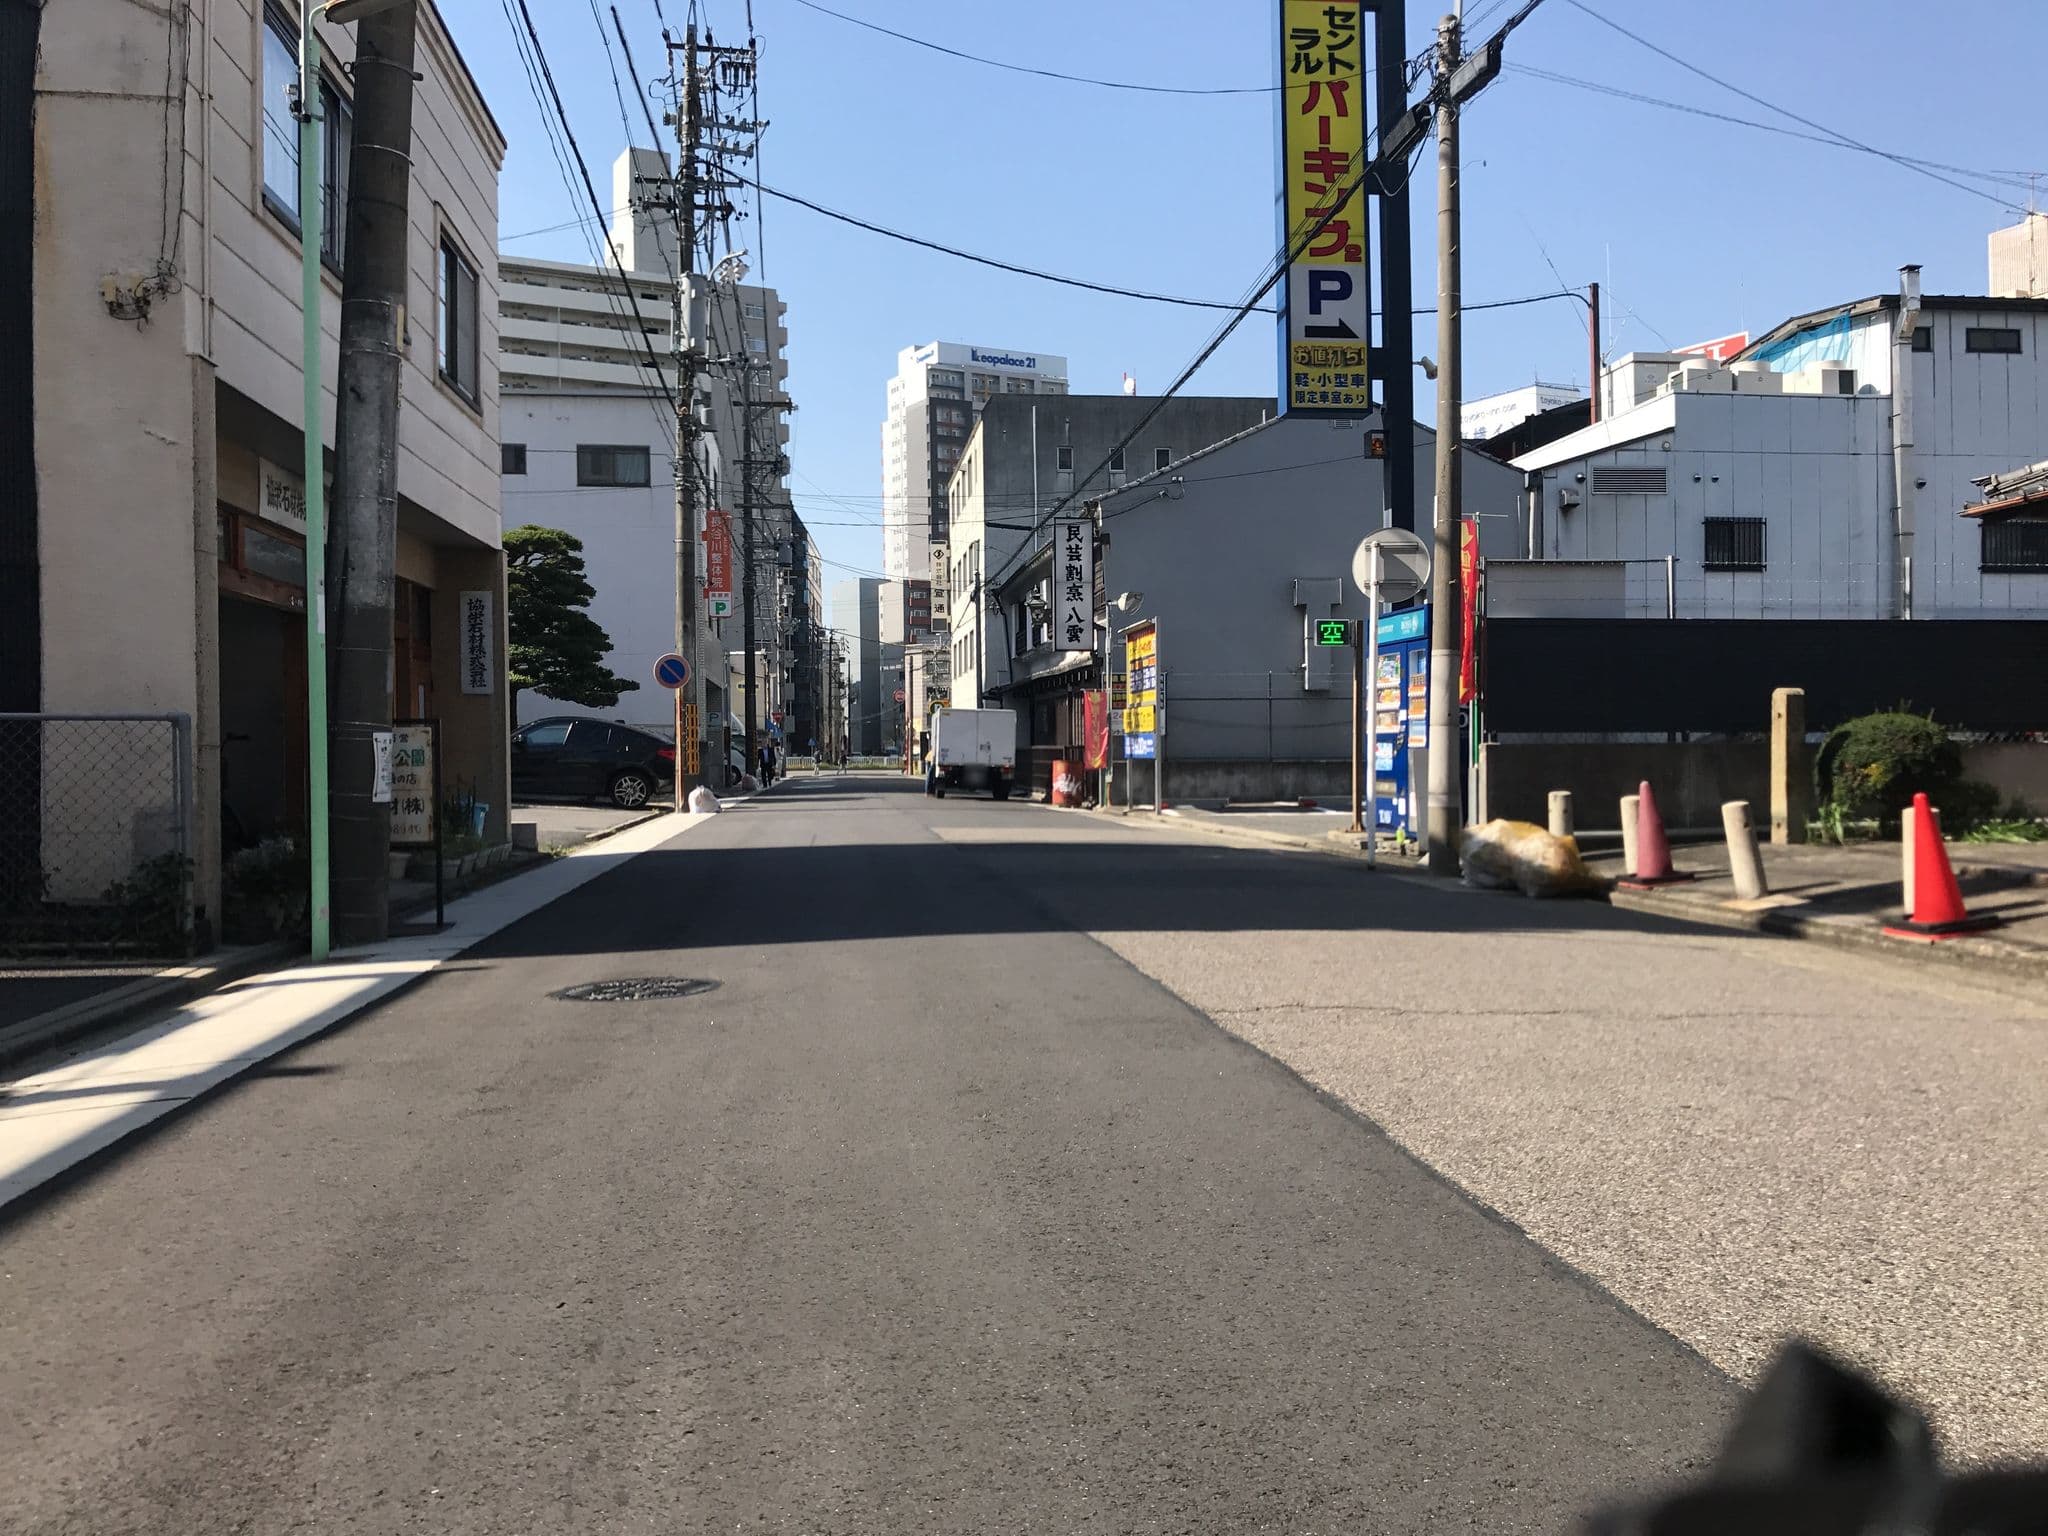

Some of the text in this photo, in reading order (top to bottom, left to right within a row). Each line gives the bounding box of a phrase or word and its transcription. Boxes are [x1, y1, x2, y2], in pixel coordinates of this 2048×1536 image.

[1290, 28, 1324, 75] ラル
[1322, 6, 1356, 75] セント
[1302, 80, 1362, 263] パーキング 2
[1308, 269, 1353, 315] P
[971, 348, 1036, 368] Leopalace 21
[1295, 391, 1365, 405] 限定車室あり
[1065, 606, 1085, 643] 八雲
[1320, 621, 1345, 644] 空
[393, 748, 425, 767] 公園
